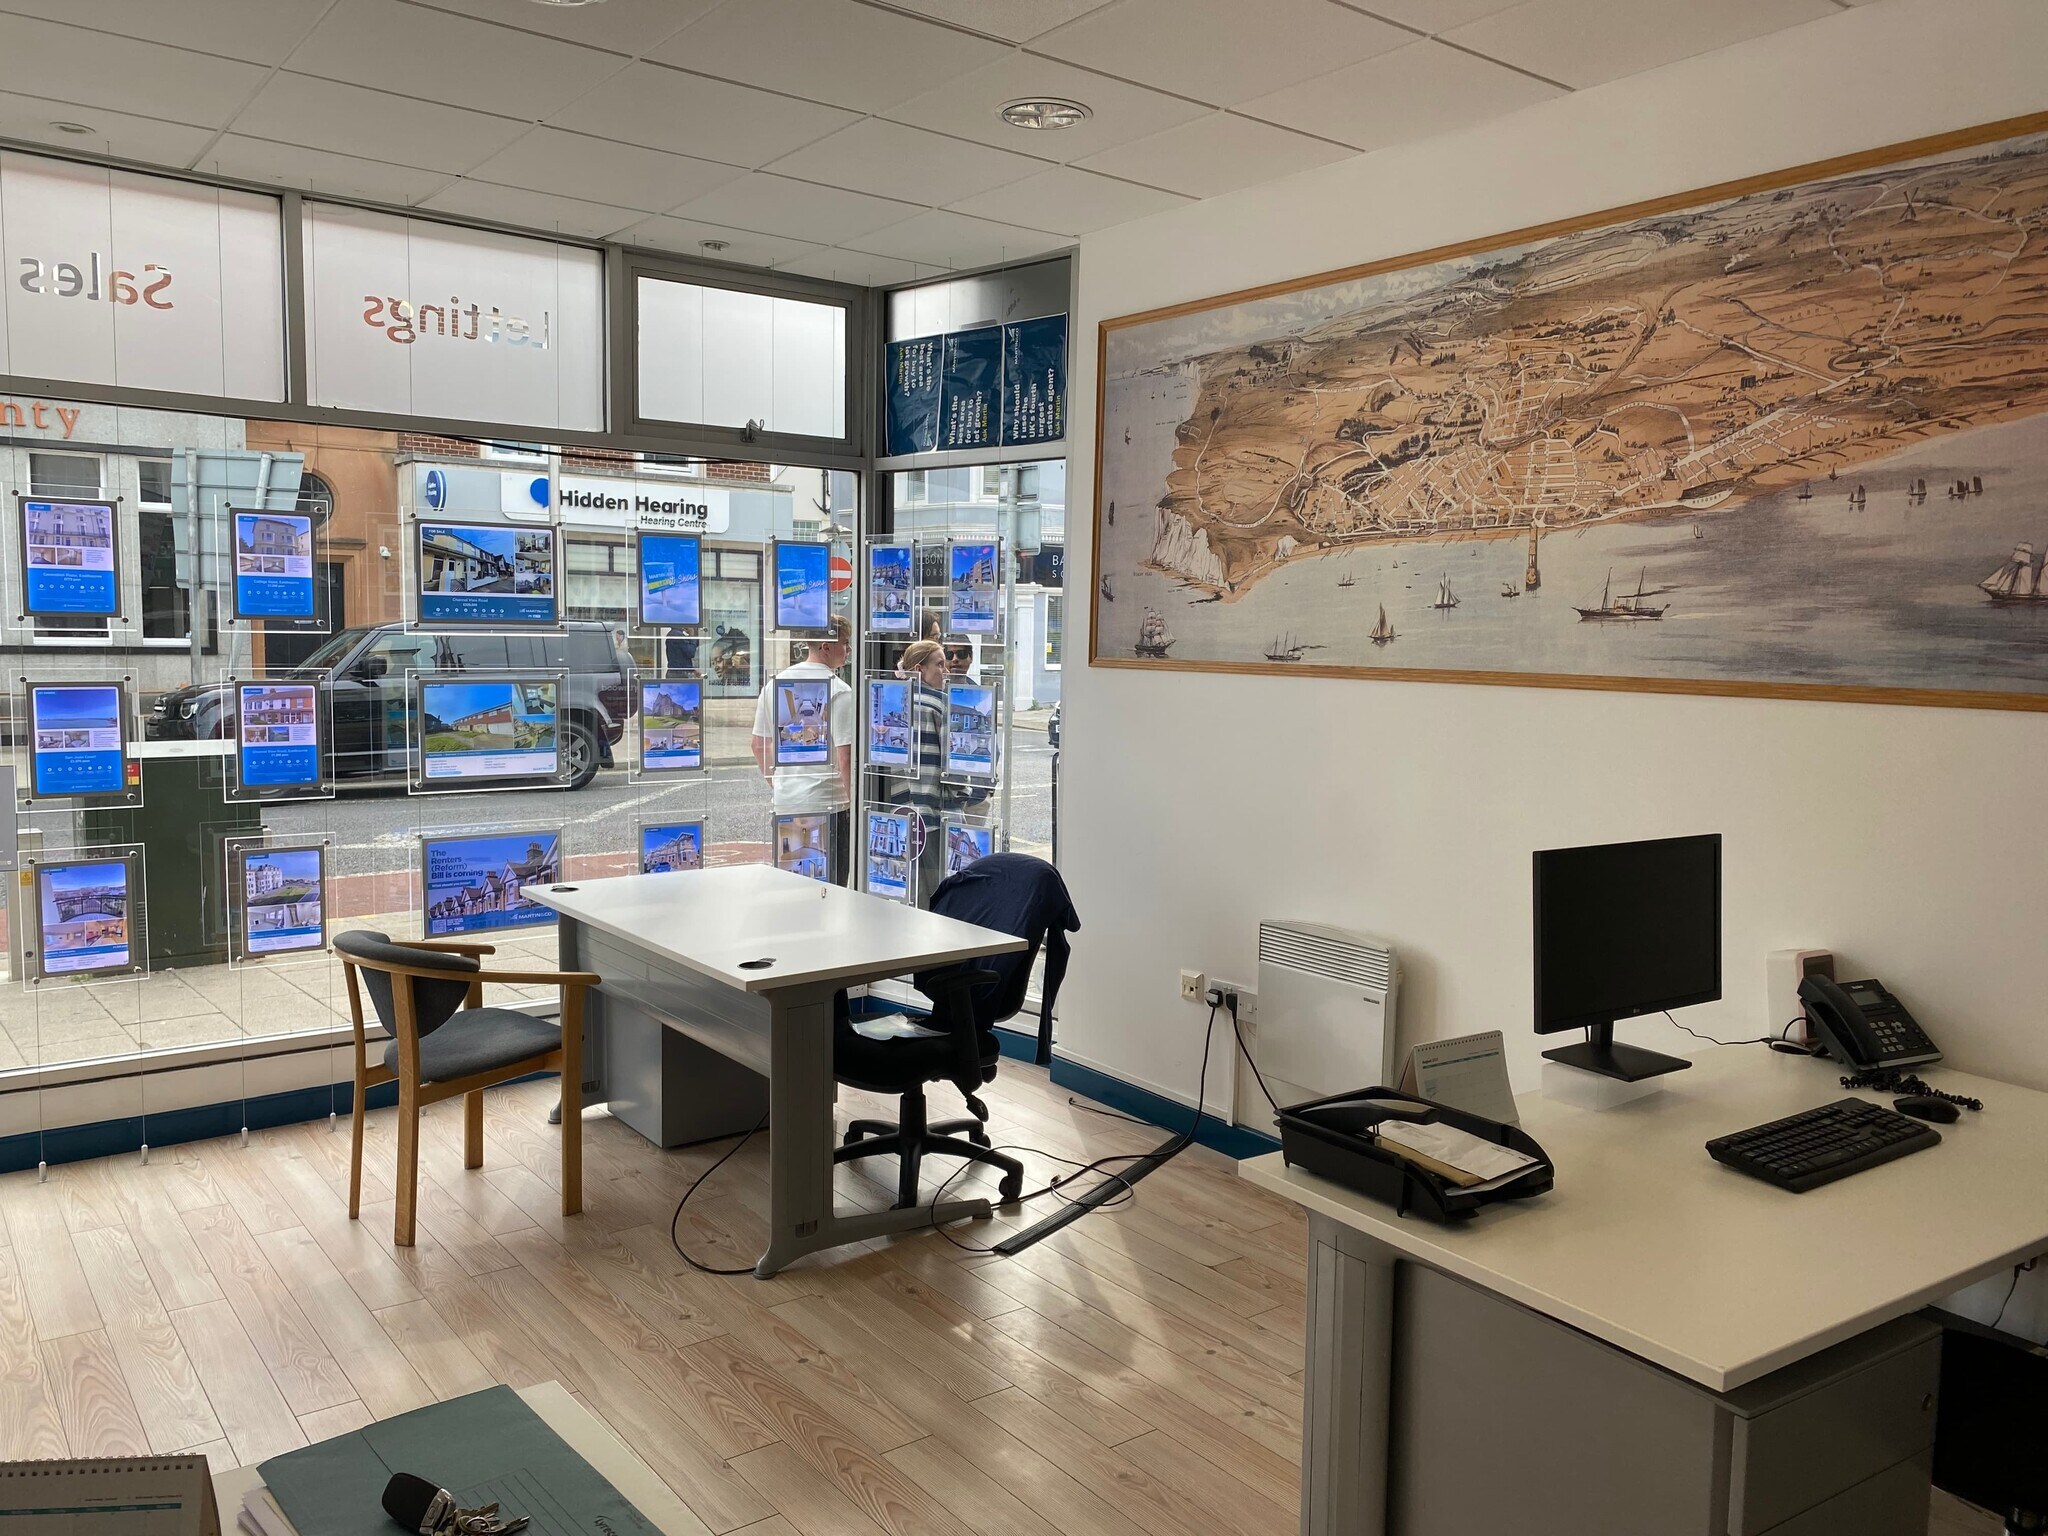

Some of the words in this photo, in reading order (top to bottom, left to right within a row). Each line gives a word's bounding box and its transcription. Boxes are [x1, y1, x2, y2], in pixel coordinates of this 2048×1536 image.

[911, 379, 917, 388] to
[1047, 368, 1055, 402] agent?
[950, 395, 958, 411] the
[967, 399, 974, 408] to
[1029, 383, 1037, 413] fourth
[974, 390, 983, 428] growth?
[966, 410, 975, 427] buy
[1028, 416, 1036, 438] UK's
[1037, 402, 1045, 437] largest
[948, 413, 958, 444] What's
[957, 424, 965, 444] best
[1012, 419, 1021, 439] Why
[559, 490, 628, 510] Hidden
[636, 495, 708, 520] Hearing
[640, 515, 676, 528] Hearing
[678, 517, 706, 528] Centre
[431, 856, 462, 864] Renters
[431, 863, 468, 872] (Reform)
[431, 871, 444, 880] Bill
[453, 869, 484, 877] coming
[518, 912, 552, 920] MARTIN&CO
